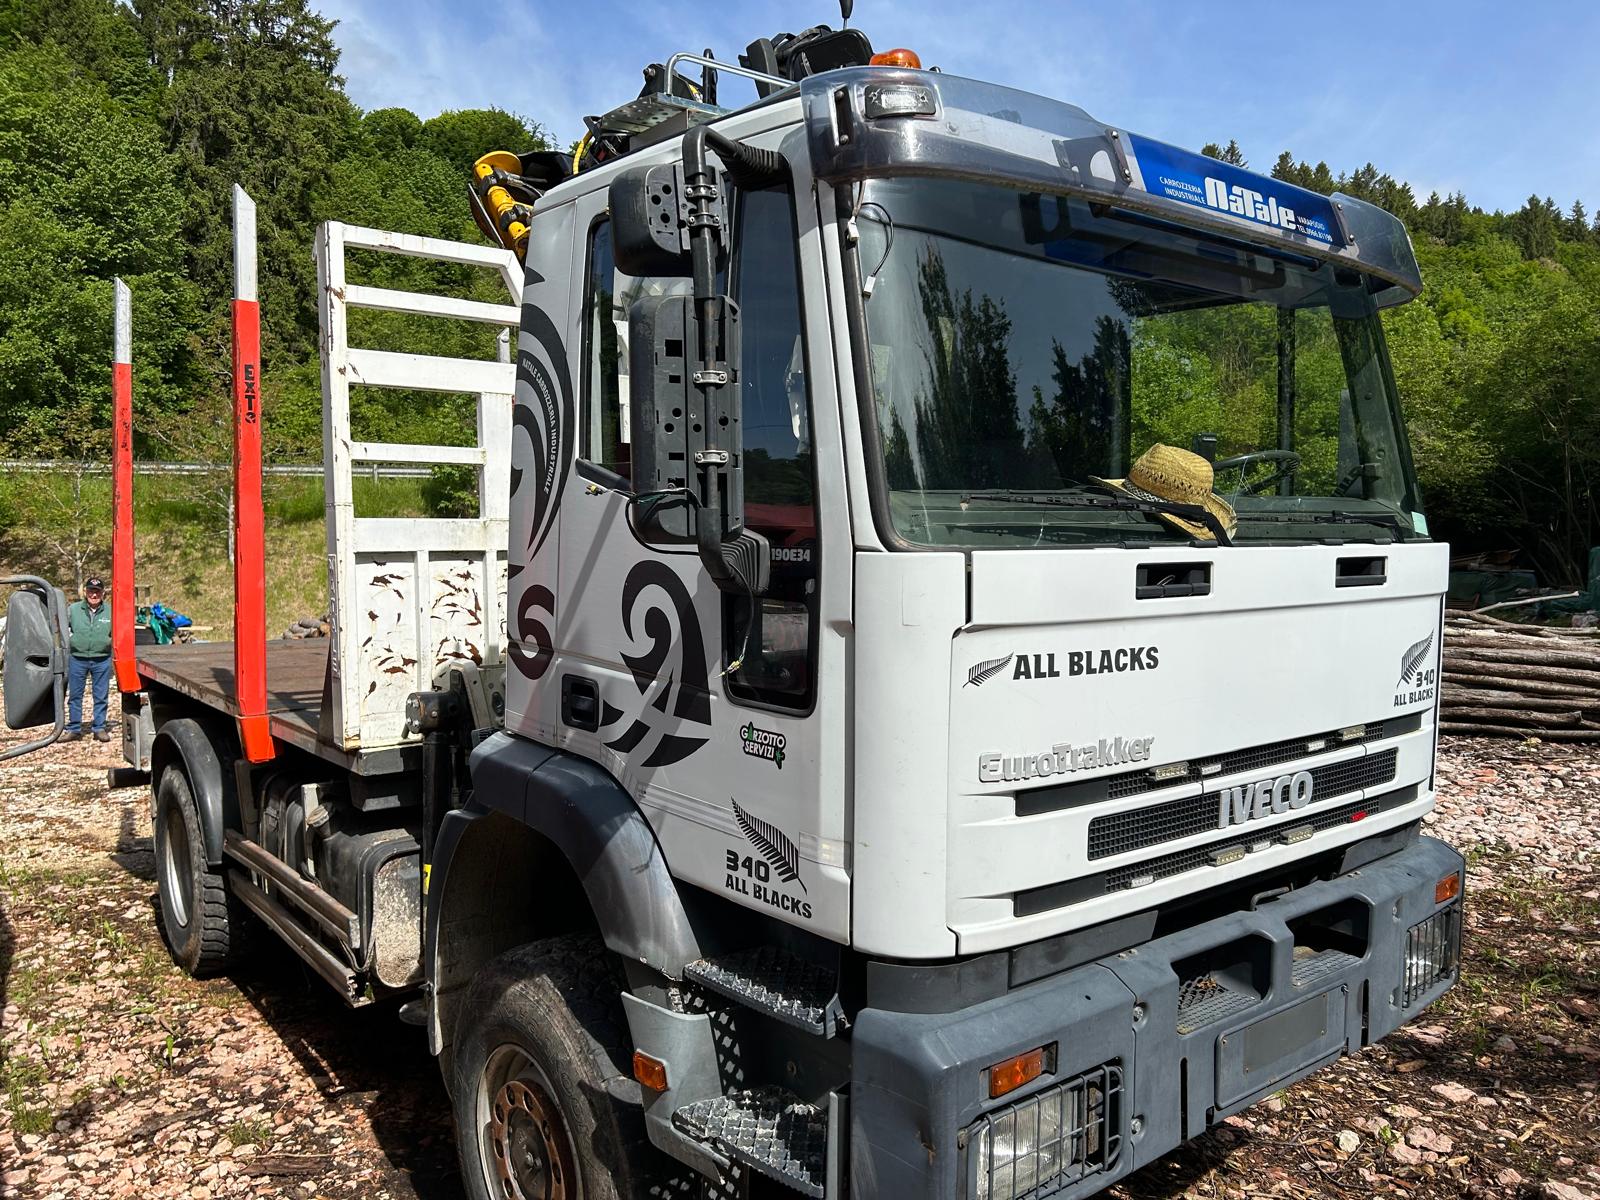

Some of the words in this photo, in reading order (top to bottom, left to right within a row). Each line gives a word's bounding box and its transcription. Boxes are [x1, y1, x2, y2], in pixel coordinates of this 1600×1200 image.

[1159, 176, 1203, 195] CARROZZERIA
[1164, 187, 1206, 205] INDUSTRIALE
[522, 358, 538, 377] NATALE
[535, 373, 556, 427] CARROZZERIA
[543, 428, 558, 495] INDUSTRIALE
[771, 547, 811, 562] 190E34
[1012, 653, 1061, 681] ALL
[1067, 646, 1160, 677] BLACKS
[1416, 668, 1435, 688] 340
[1393, 693, 1407, 707] ALL
[1408, 687, 1434, 704] BLACKS
[744, 740, 775, 759] SERVIZI
[979, 736, 1155, 783] EuroTrakker
[1218, 770, 1314, 829] IVECO
[727, 849, 769, 883] 340
[725, 873, 749, 895] ALL
[752, 882, 813, 919] BLACKS
